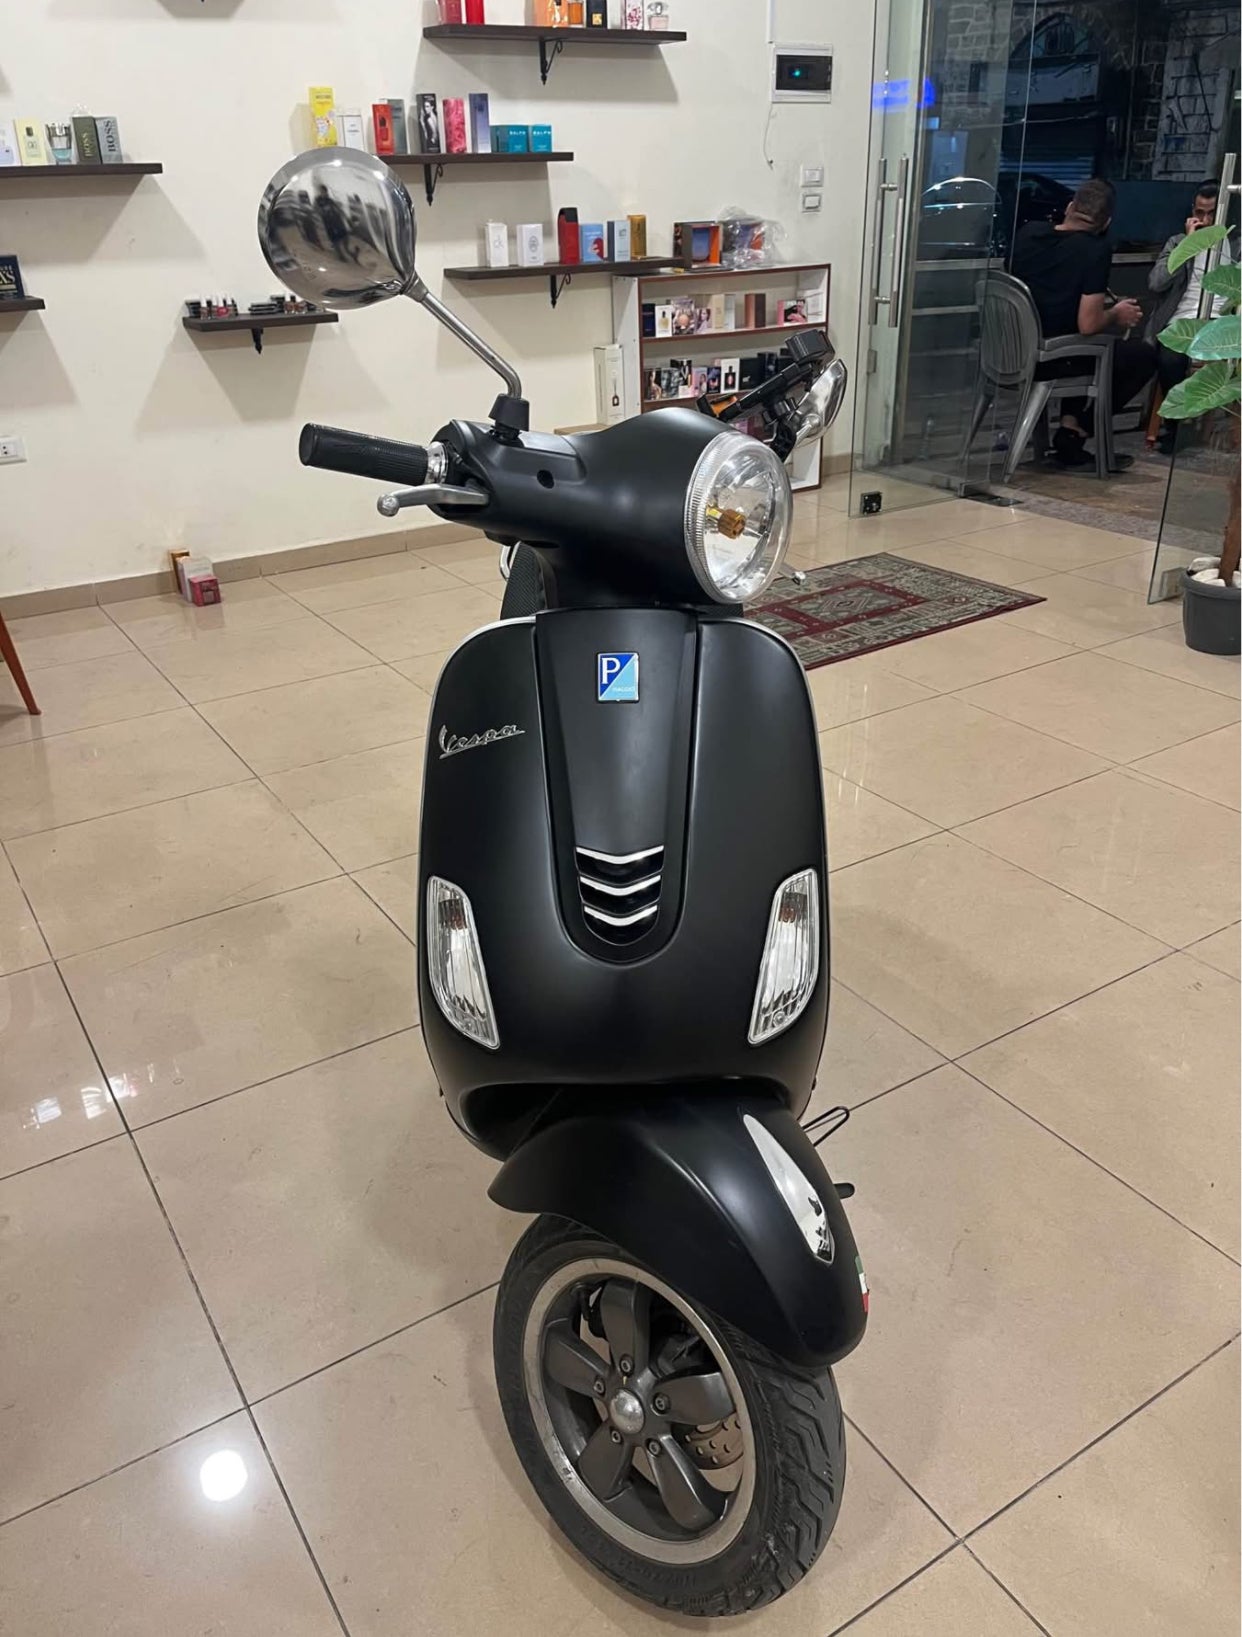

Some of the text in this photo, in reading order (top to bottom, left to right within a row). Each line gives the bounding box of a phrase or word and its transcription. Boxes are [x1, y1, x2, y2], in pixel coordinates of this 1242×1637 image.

[103, 120, 116, 152] BOSS
[601, 657, 621, 685] P
[438, 724, 525, 760] Vespa
